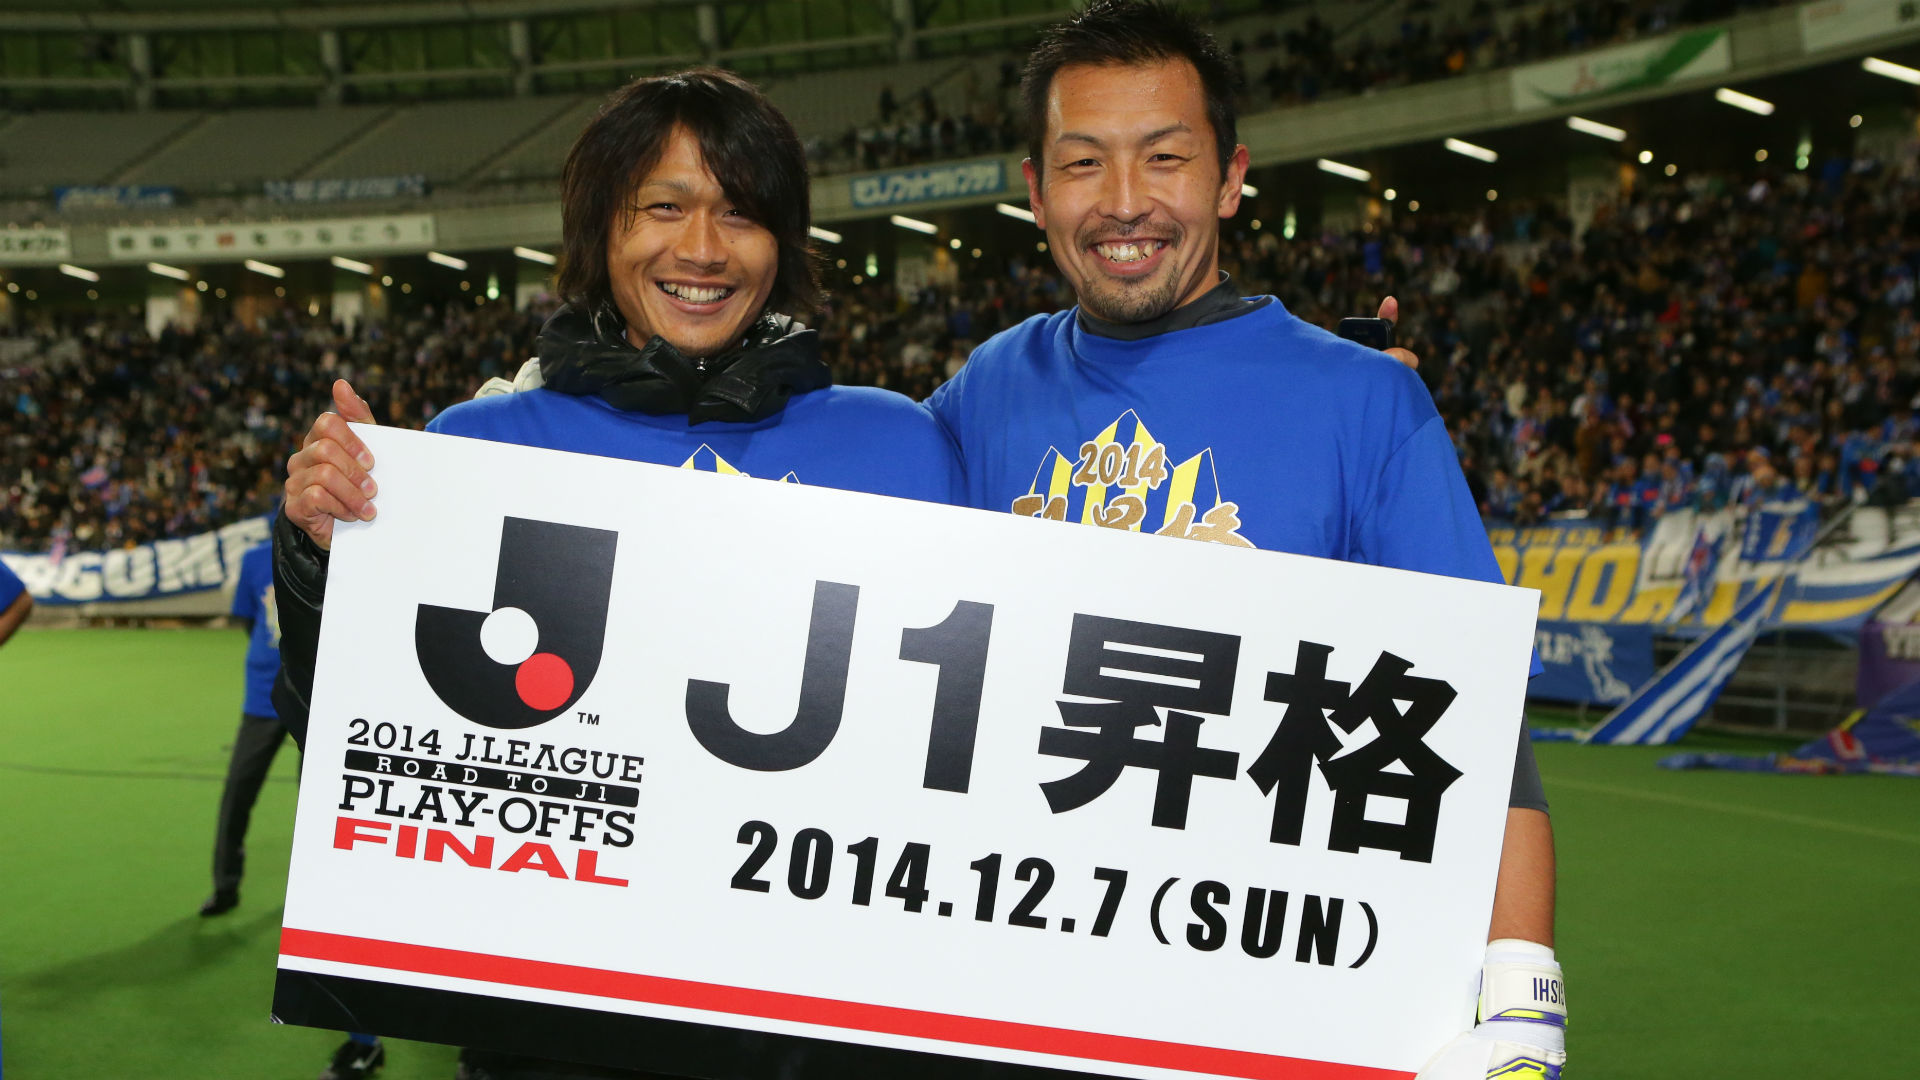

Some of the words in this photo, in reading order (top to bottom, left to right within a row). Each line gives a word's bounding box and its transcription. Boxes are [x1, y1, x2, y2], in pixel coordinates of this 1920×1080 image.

[1073, 441, 1167, 490] 2014
[577, 711, 600, 726] TM
[348, 718, 442, 756] 2014
[455, 733, 645, 784] J.LEAGUE
[376, 756, 479, 784] ROAD
[507, 773, 548, 793] TO
[575, 783, 607, 802] J1
[339, 775, 636, 848] PLAY-OFFS
[333, 816, 629, 888] FINAL
